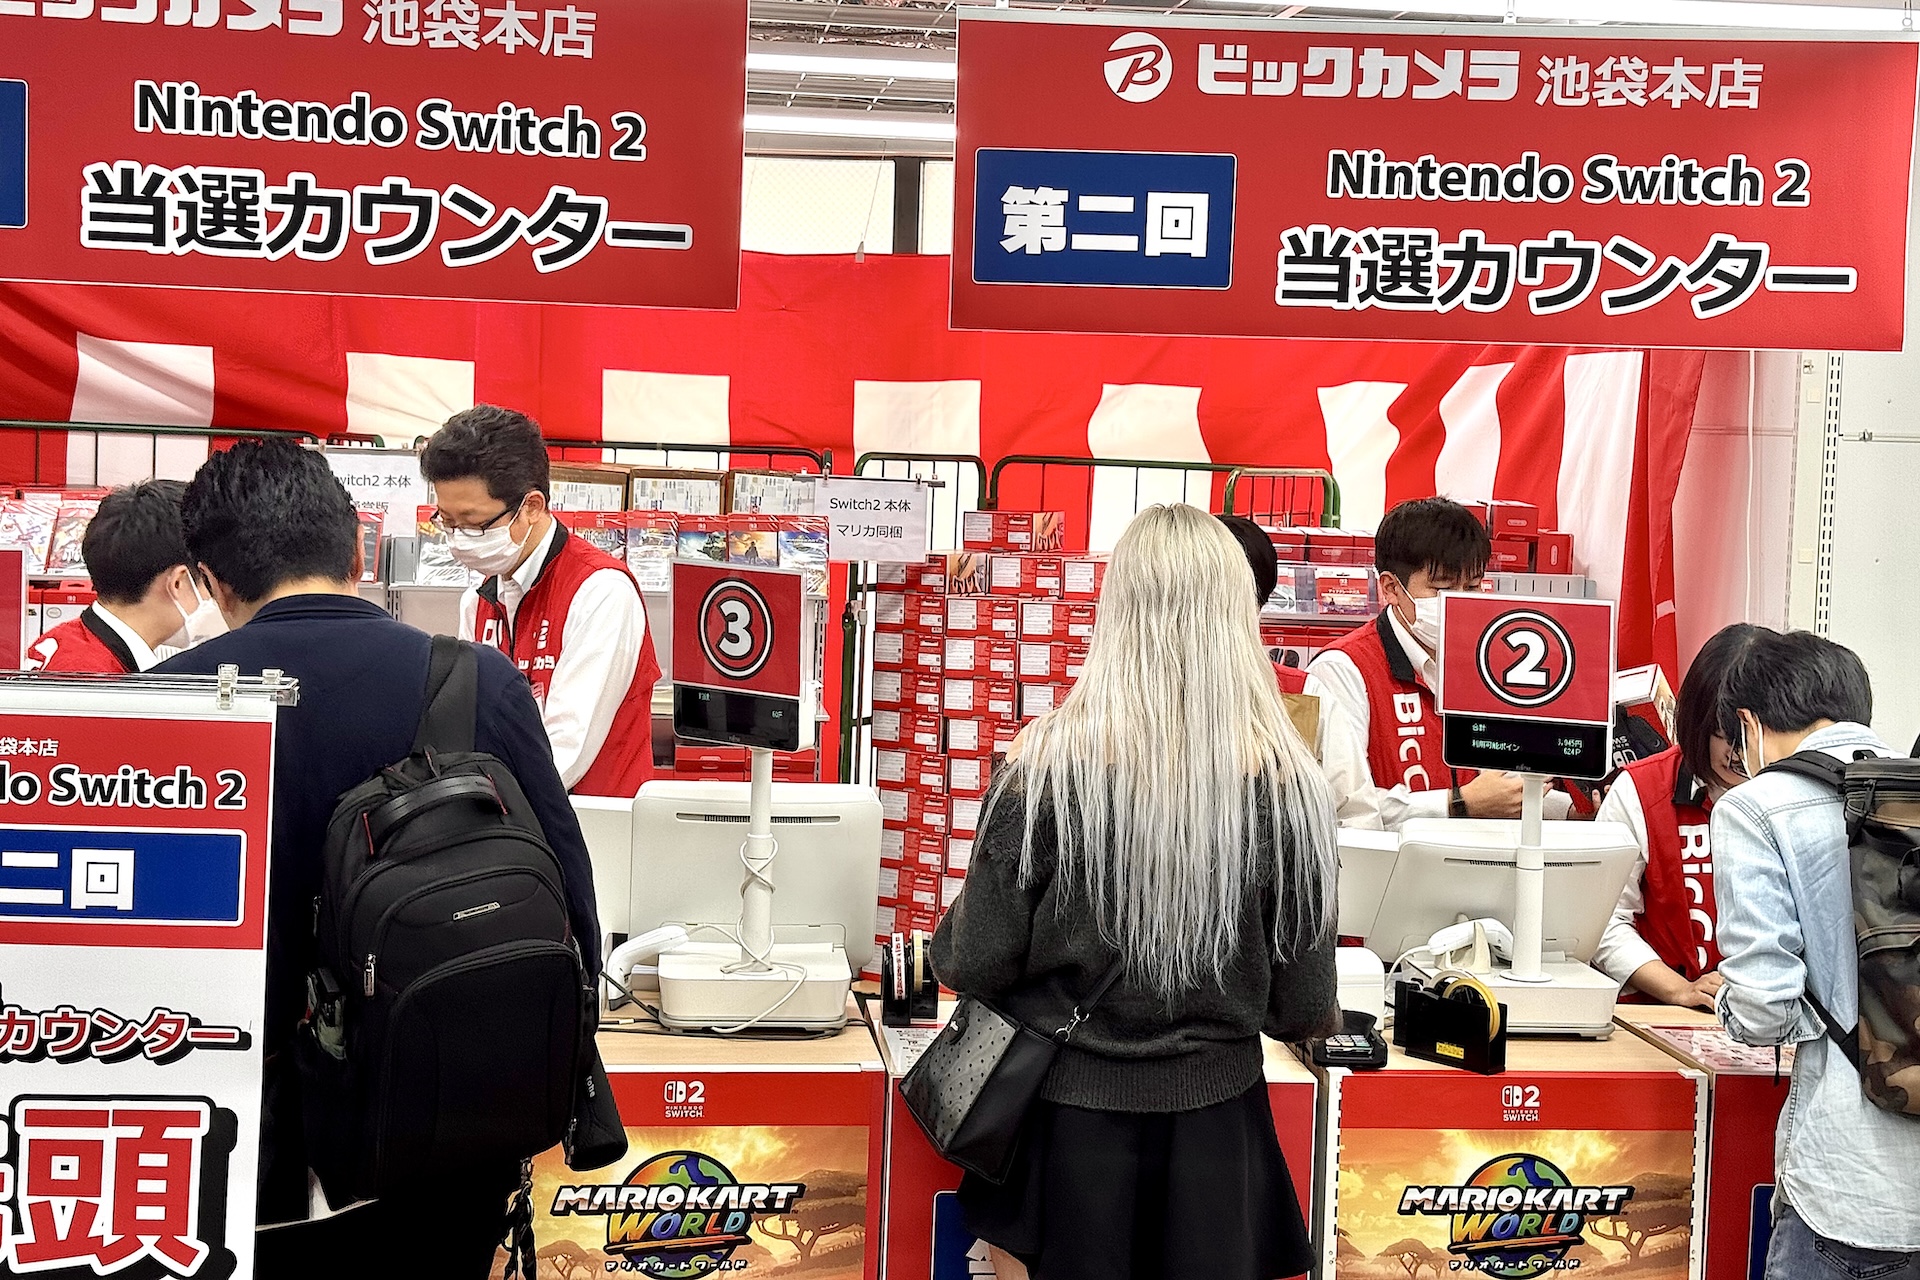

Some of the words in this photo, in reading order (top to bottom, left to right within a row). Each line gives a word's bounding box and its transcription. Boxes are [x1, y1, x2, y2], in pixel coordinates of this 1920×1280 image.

[361, 0, 597, 58] 池袋本店
[1198, 43, 1520, 102] ビックカメラ
[1536, 56, 1764, 110] 池袋本店
[136, 81, 405, 147] Nintendo
[417, 103, 600, 158] Switch
[611, 113, 646, 160] 2
[1328, 151, 1573, 204] Nintendo
[1581, 155, 1760, 205] Switch
[1772, 158, 1810, 206] 2
[82, 162, 692, 272] 当選カウンター
[999, 185, 1211, 256] 第二回
[1276, 227, 1857, 315] 当選カウンター
[383, 474, 412, 488] 本体
[829, 498, 881, 511] Switch2
[884, 498, 912, 513] 本体
[836, 524, 903, 539] マリカ同梱
[50, 765, 204, 807] Switch
[216, 770, 246, 808] 2
[665, 1110, 704, 1118] SWITCH
[1503, 1114, 1539, 1122] SWITCH
[0, 1108, 202, 1268] 頭
[609, 1211, 747, 1243] WORLD
[1452, 1212, 1580, 1243] WORLD
